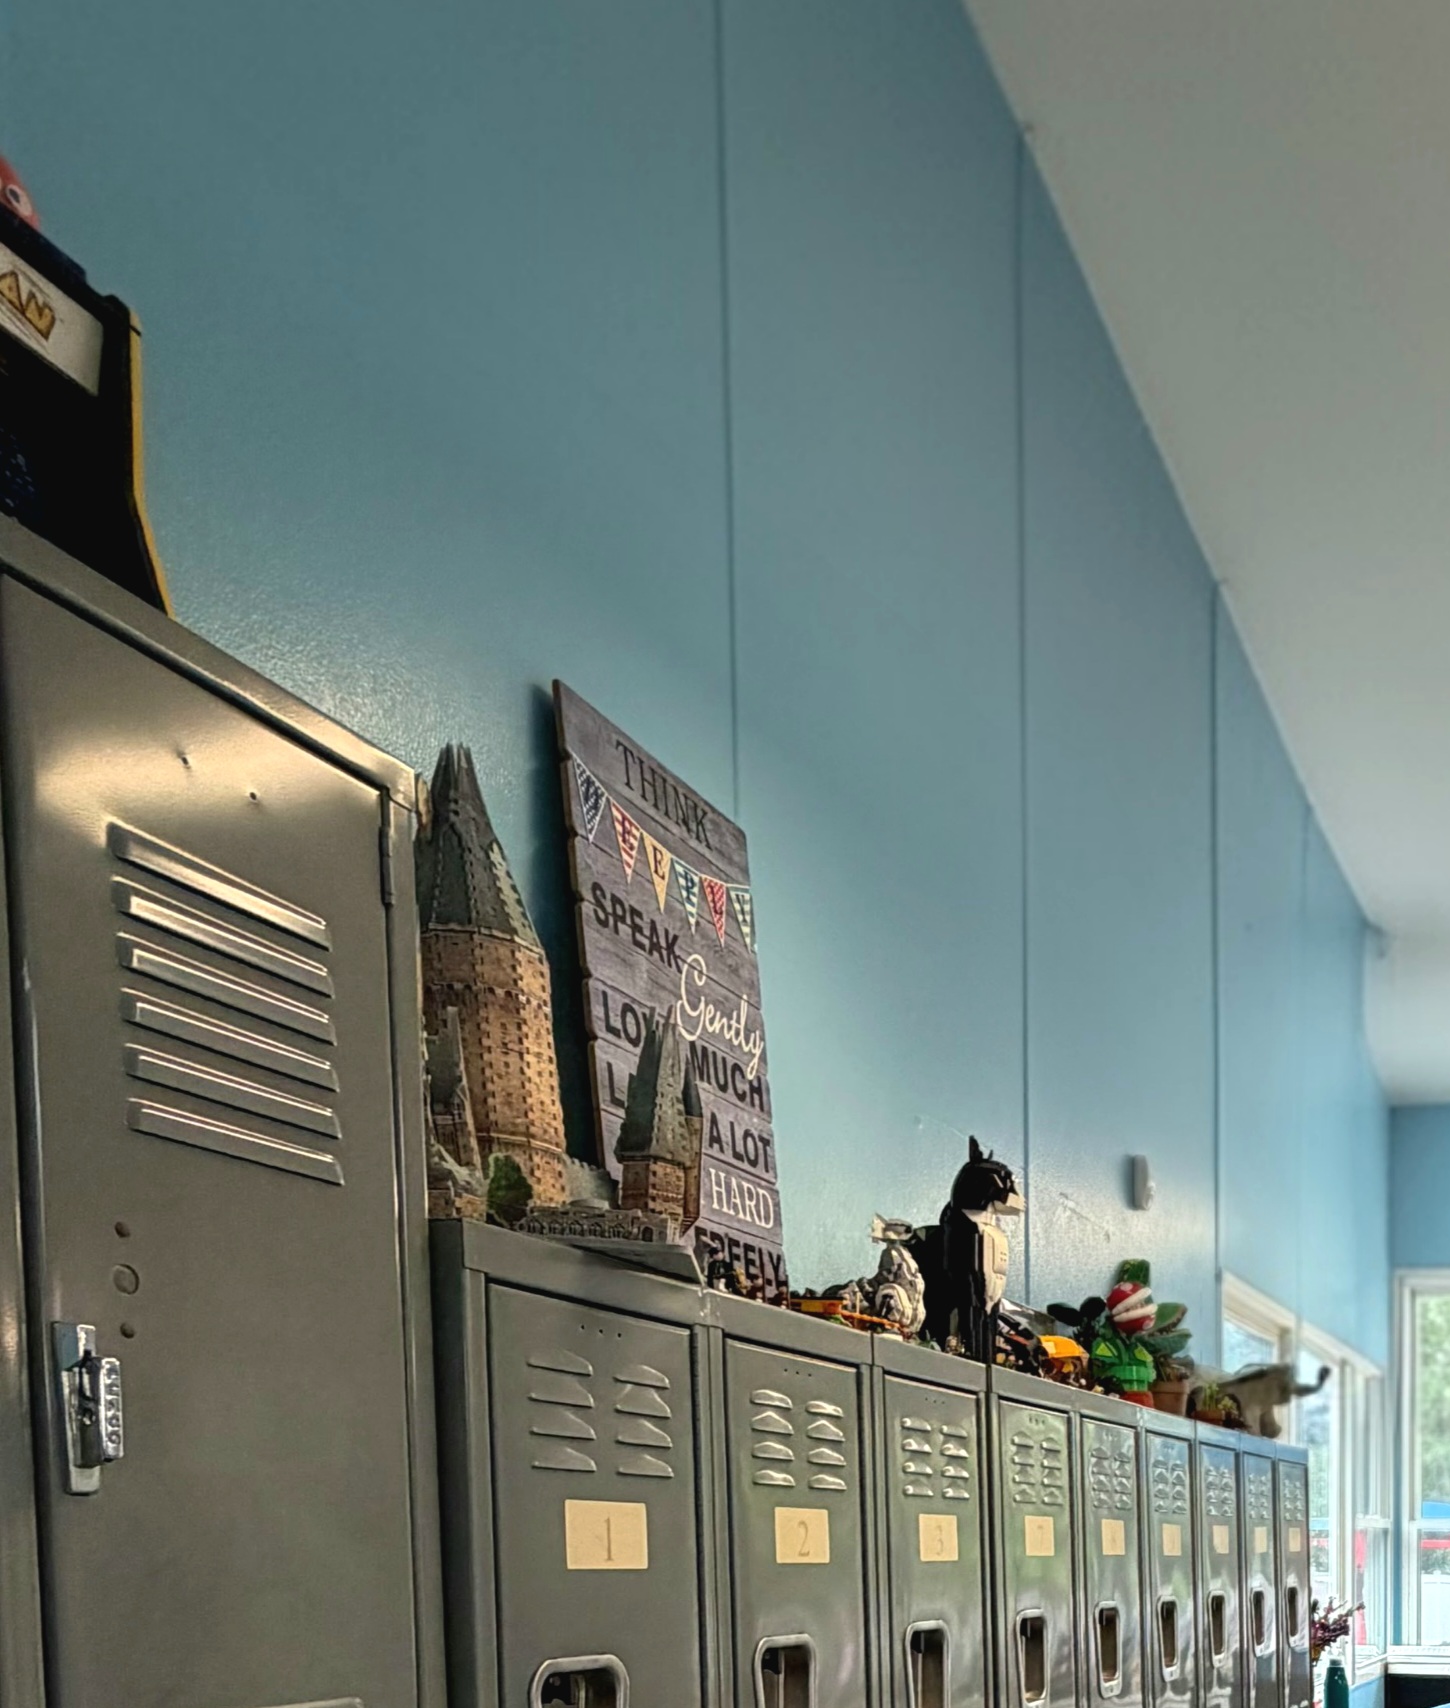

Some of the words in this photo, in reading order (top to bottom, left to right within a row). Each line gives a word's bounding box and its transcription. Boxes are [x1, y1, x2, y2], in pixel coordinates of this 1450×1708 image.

[615, 740, 713, 851] THINK
[591, 882, 683, 974] SPEAK
[676, 953, 765, 1080] Gently
[688, 1041, 765, 1112] MUCH
[709, 1112, 725, 1154] A
[730, 1121, 770, 1173] LOT
[709, 1168, 774, 1229] HARD
[604, 1516, 614, 1561] 1
[797, 1520, 810, 1557] 2
[936, 1525, 944, 1557] 3
